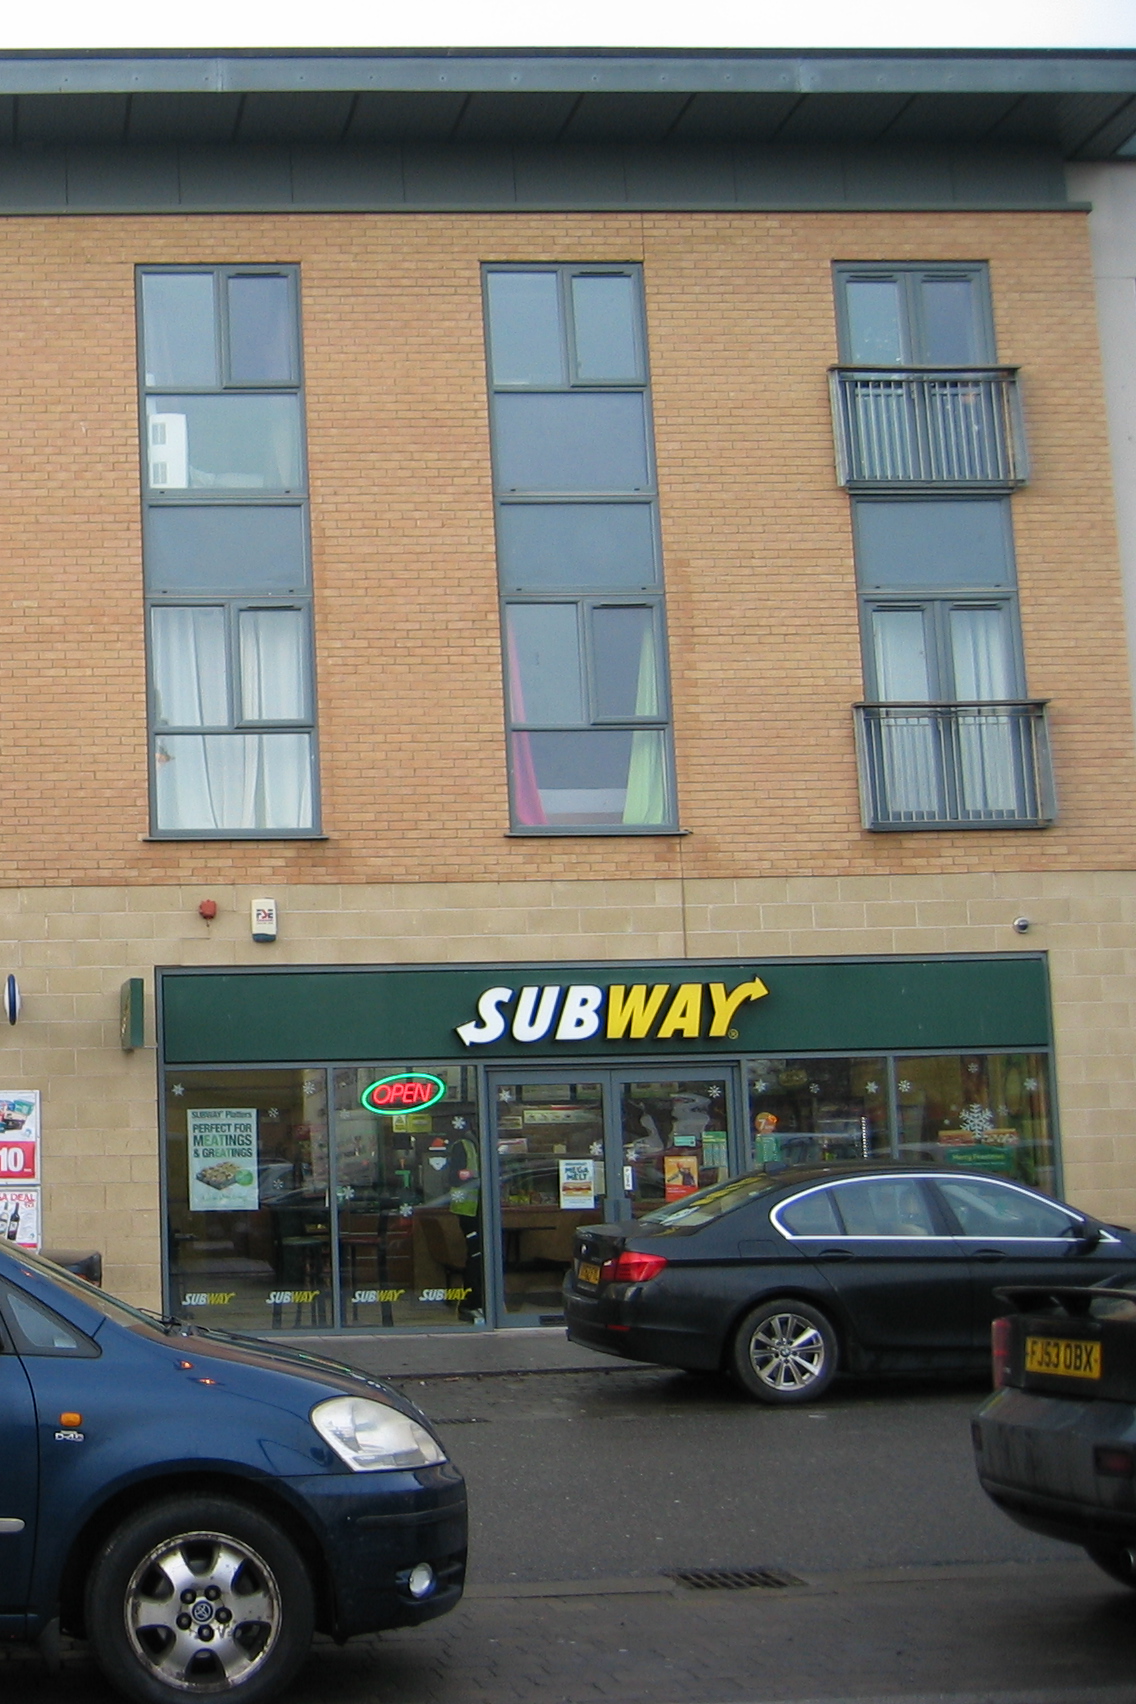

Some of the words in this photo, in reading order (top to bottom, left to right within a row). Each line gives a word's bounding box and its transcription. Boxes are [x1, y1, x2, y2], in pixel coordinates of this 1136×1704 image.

[457, 976, 768, 1045] SUBWAY
[372, 1082, 432, 1104] OPEN
[192, 1123, 232, 1133] PERFECT
[234, 1123, 252, 1133] FOR
[193, 1134, 252, 1146] MEATINGS
[193, 1149, 200, 1158] &
[202, 1148, 252, 1157] GREATINGS
[10, 1193, 35, 1202] DEAL
[182, 1292, 236, 1305] SUBWAY
[266, 1290, 320, 1304] SUBWAY
[351, 1289, 405, 1302] SUBWAY
[419, 1288, 472, 1301] SUBWAY
[1030, 1340, 1060, 1368] FJ53
